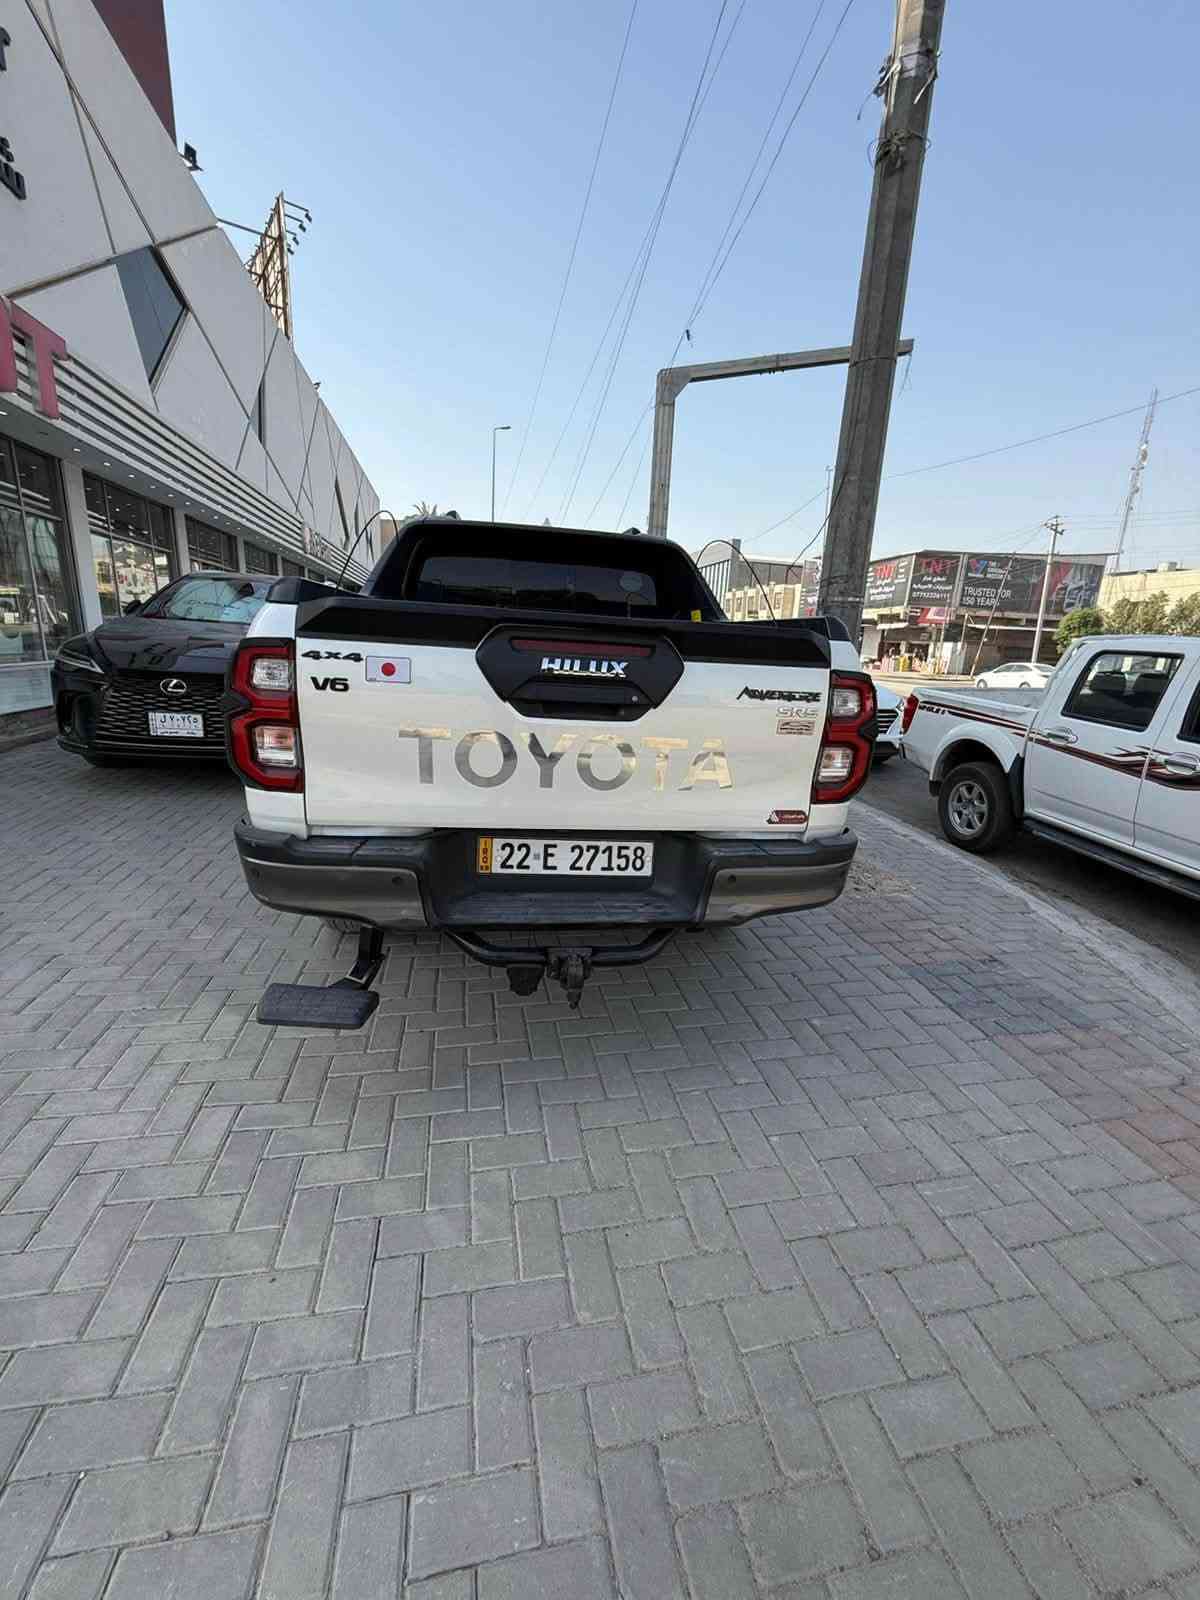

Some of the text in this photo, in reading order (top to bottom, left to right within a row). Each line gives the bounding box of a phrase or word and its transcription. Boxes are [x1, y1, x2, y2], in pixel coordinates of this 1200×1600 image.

[964, 586, 996, 598] TRUSTED
[541, 657, 628, 678] HILUX
[310, 676, 349, 692] V6
[399, 727, 733, 791] TOYOTA
[500, 842, 646, 872] 22 E 27158
